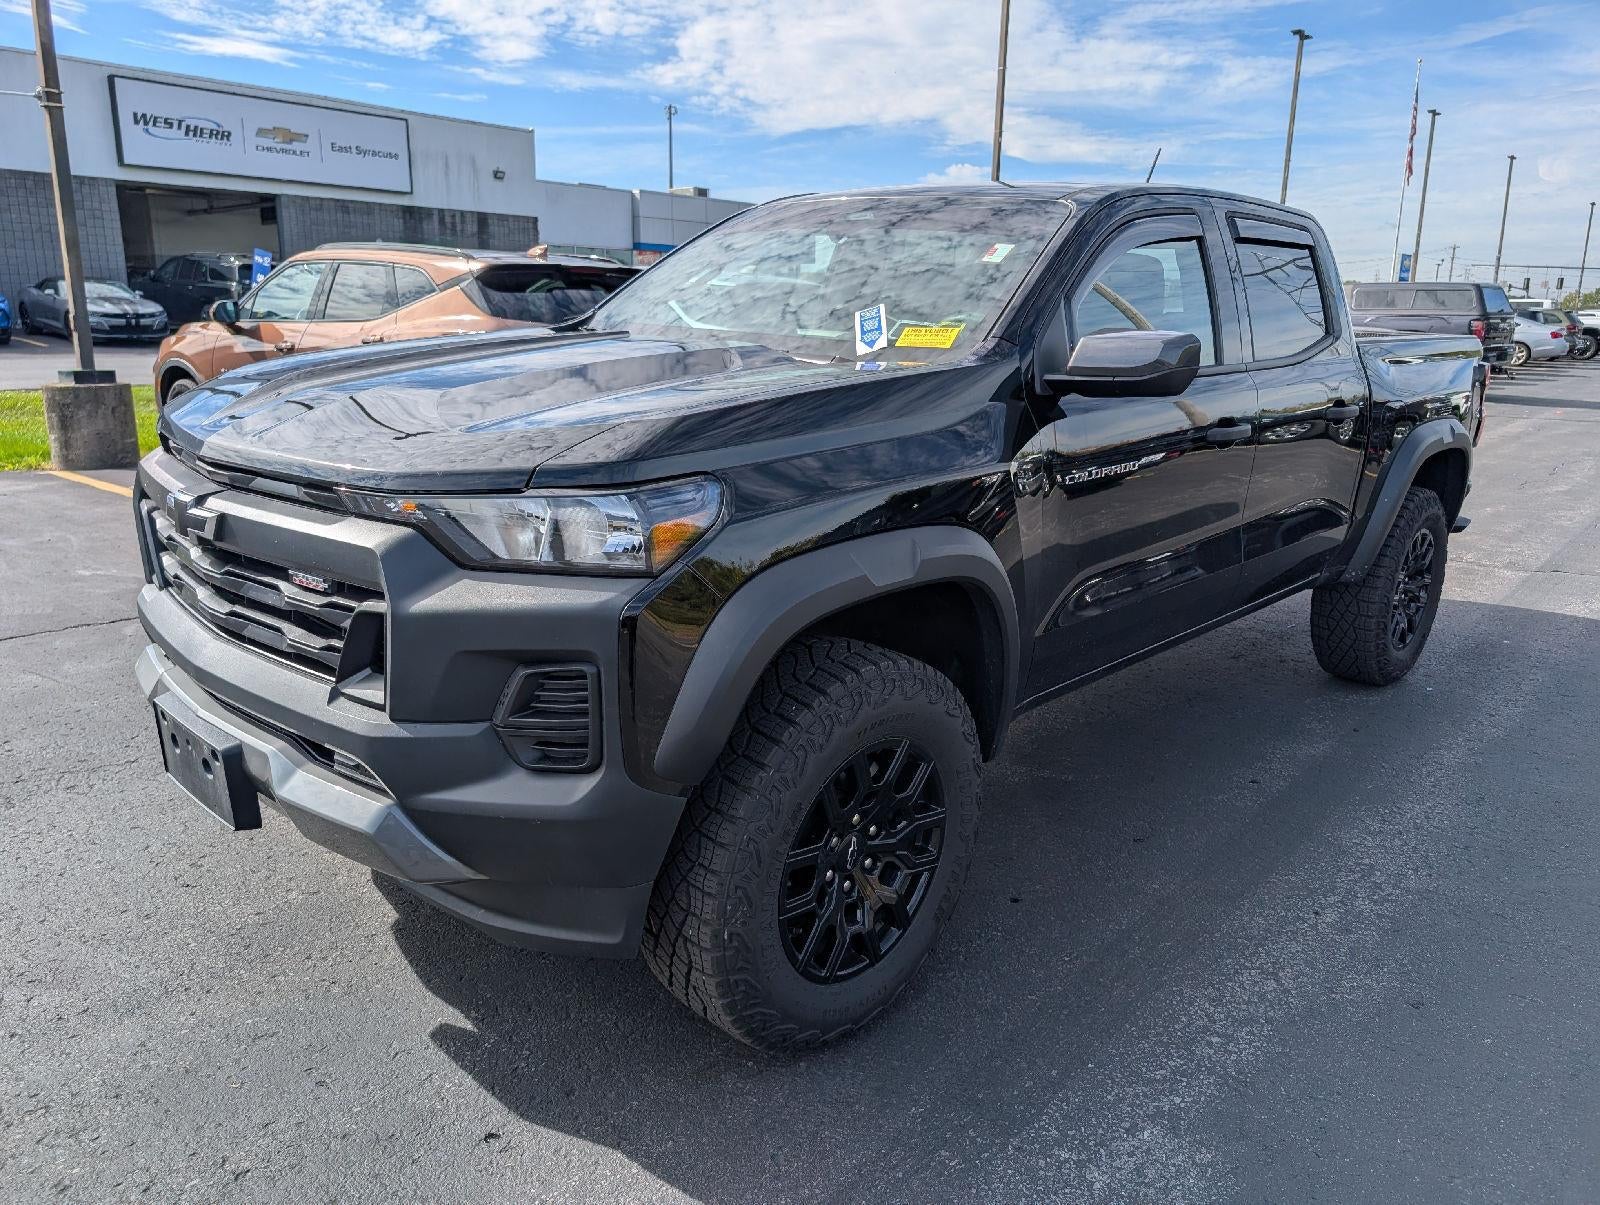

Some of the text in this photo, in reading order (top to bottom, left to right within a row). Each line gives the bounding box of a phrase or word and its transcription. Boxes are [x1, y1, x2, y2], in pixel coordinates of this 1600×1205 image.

[133, 112, 232, 142] WEST HERR
[255, 144, 311, 158] CHEVROLET
[330, 141, 400, 160] East Syracuse
[1065, 461, 1140, 485] COLORADO
